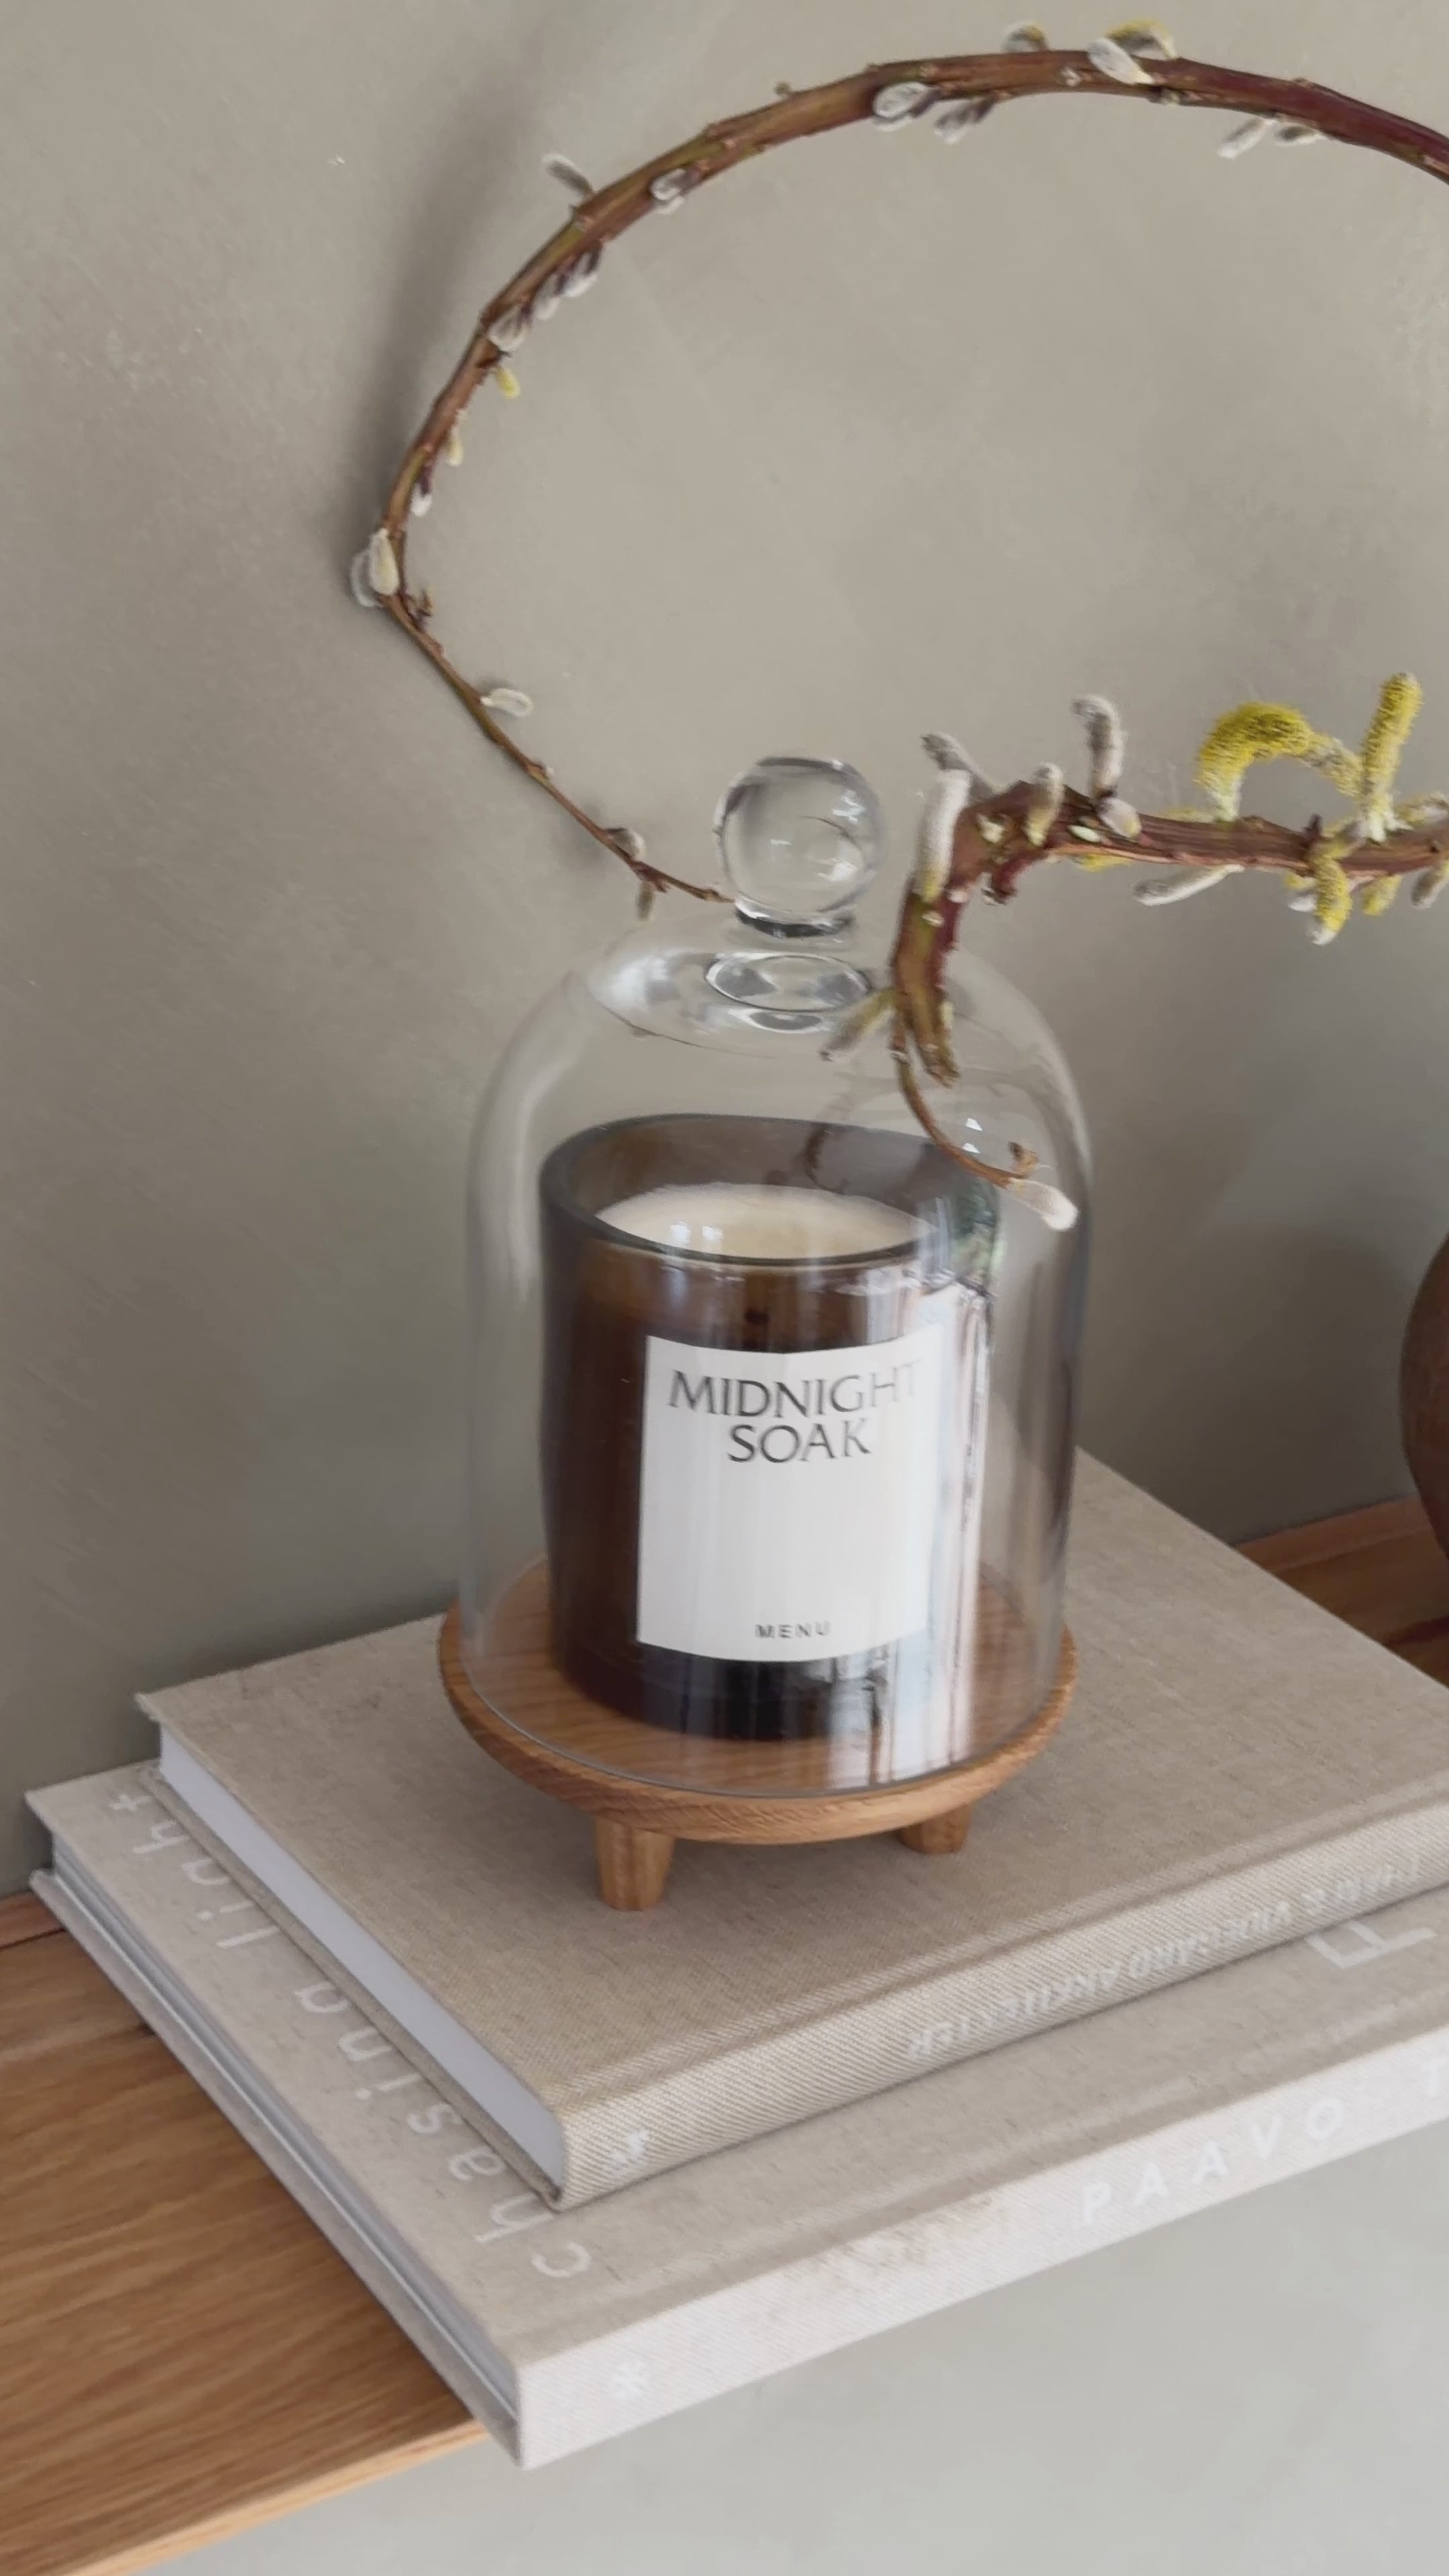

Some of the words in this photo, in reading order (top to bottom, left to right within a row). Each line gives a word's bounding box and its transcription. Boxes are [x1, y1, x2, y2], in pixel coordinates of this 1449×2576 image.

[668, 1360, 920, 1417] MIDNIGHT
[727, 1417, 871, 1463] SOAK
[755, 1621, 831, 1639] MENU
[1081, 2098, 1344, 2224] PAAVO
